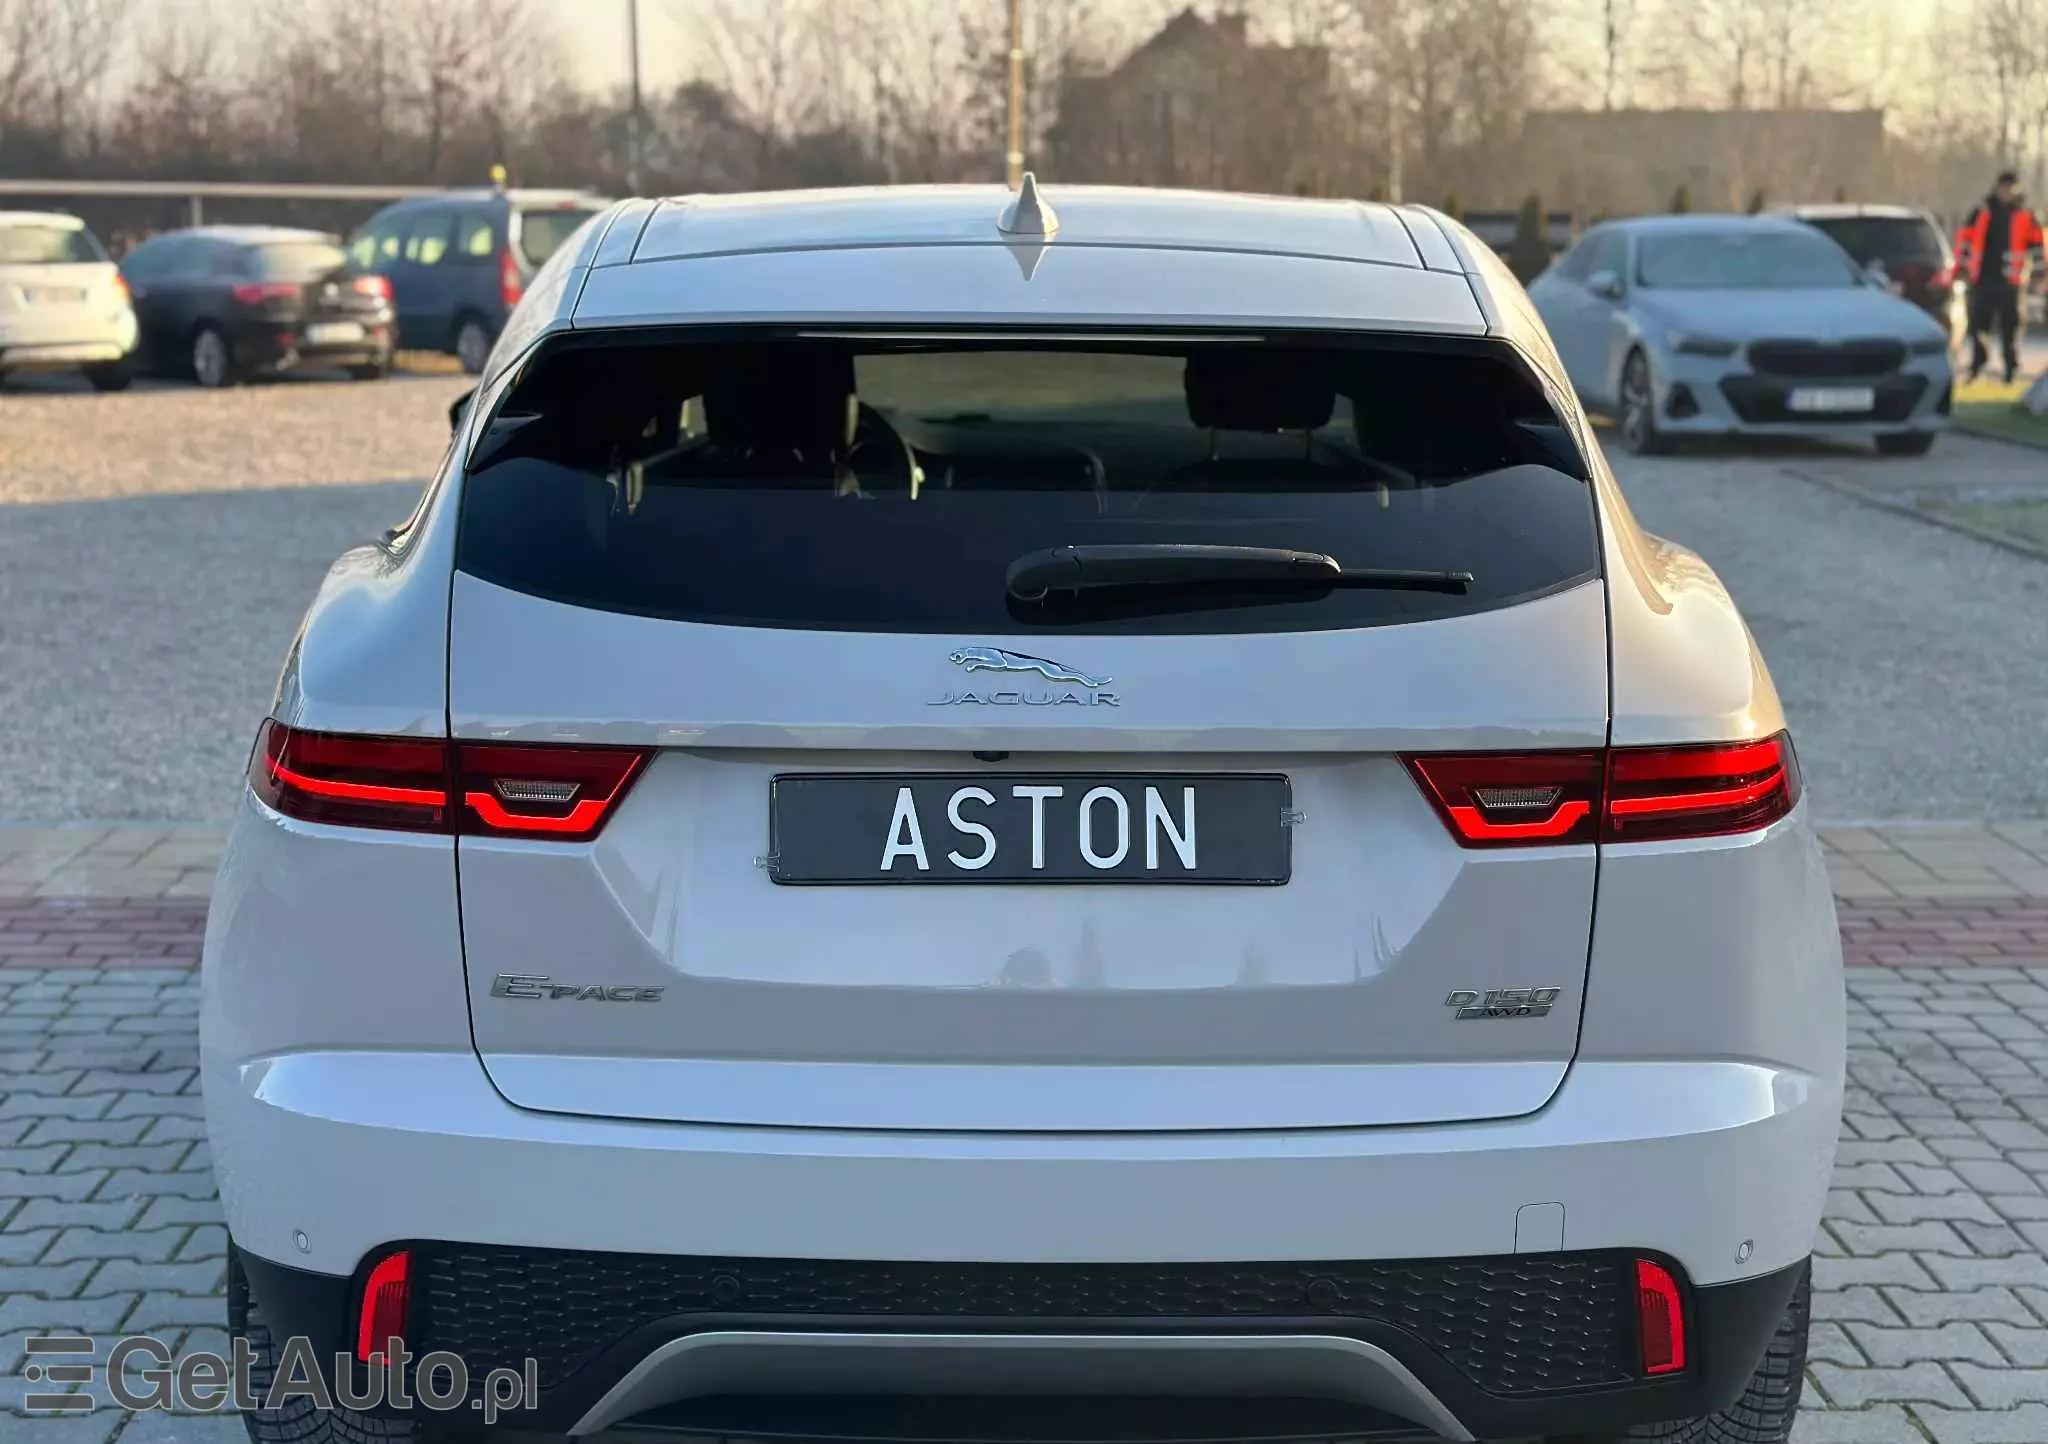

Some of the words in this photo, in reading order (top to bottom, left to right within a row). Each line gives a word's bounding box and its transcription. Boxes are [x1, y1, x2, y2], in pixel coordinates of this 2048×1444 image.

[926, 692, 1120, 706] JAGUAR
[880, 786, 1196, 871] ASTON
[1446, 986, 1560, 1006] D150
[1480, 1006, 1531, 1017] AWD
